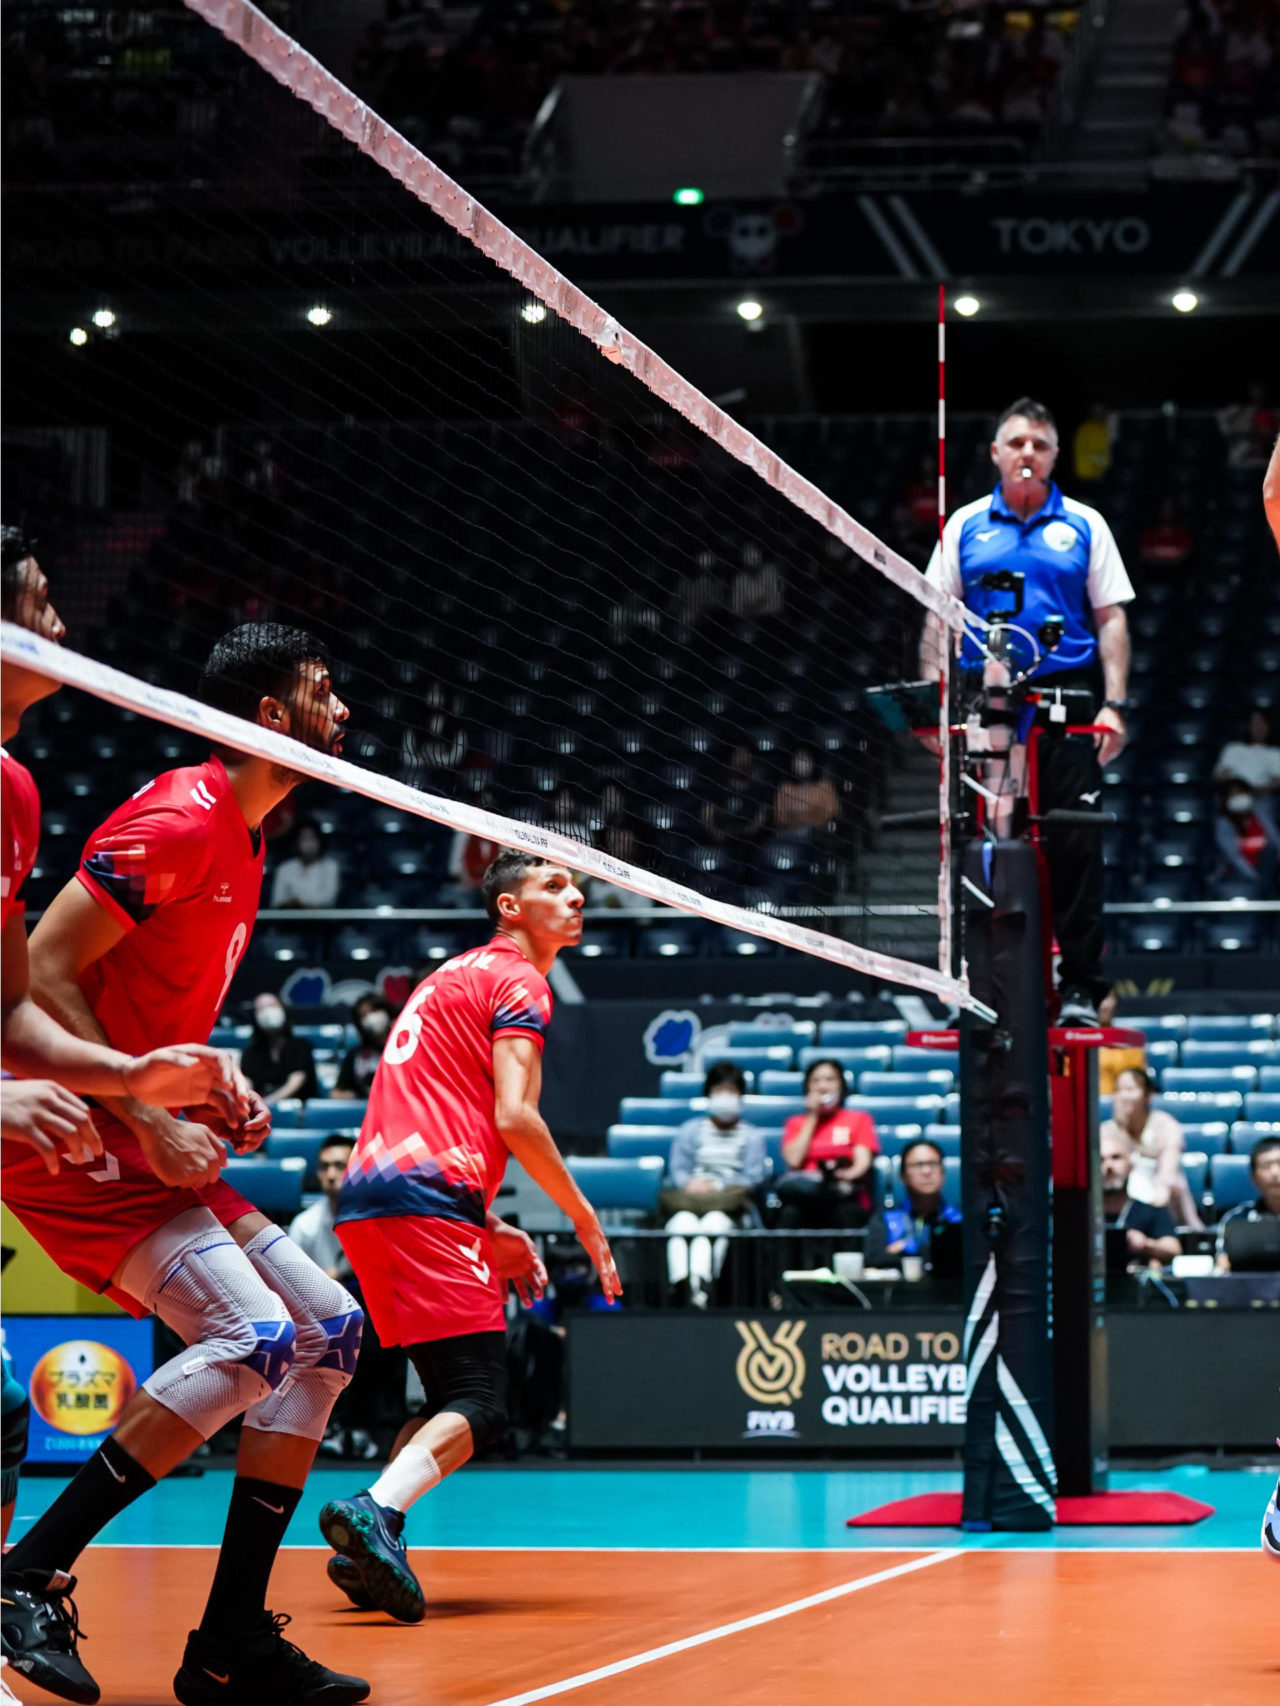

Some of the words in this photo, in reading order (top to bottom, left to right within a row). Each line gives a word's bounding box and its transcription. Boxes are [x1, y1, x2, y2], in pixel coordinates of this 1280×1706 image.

[988, 215, 1151, 255] TOKYO
[383, 985, 436, 1066] 6
[821, 1332, 909, 1361] ROAD
[915, 1331, 960, 1361] TO
[821, 1363, 967, 1393] VOLLEYB
[821, 1395, 967, 1426] QUALIFIE
